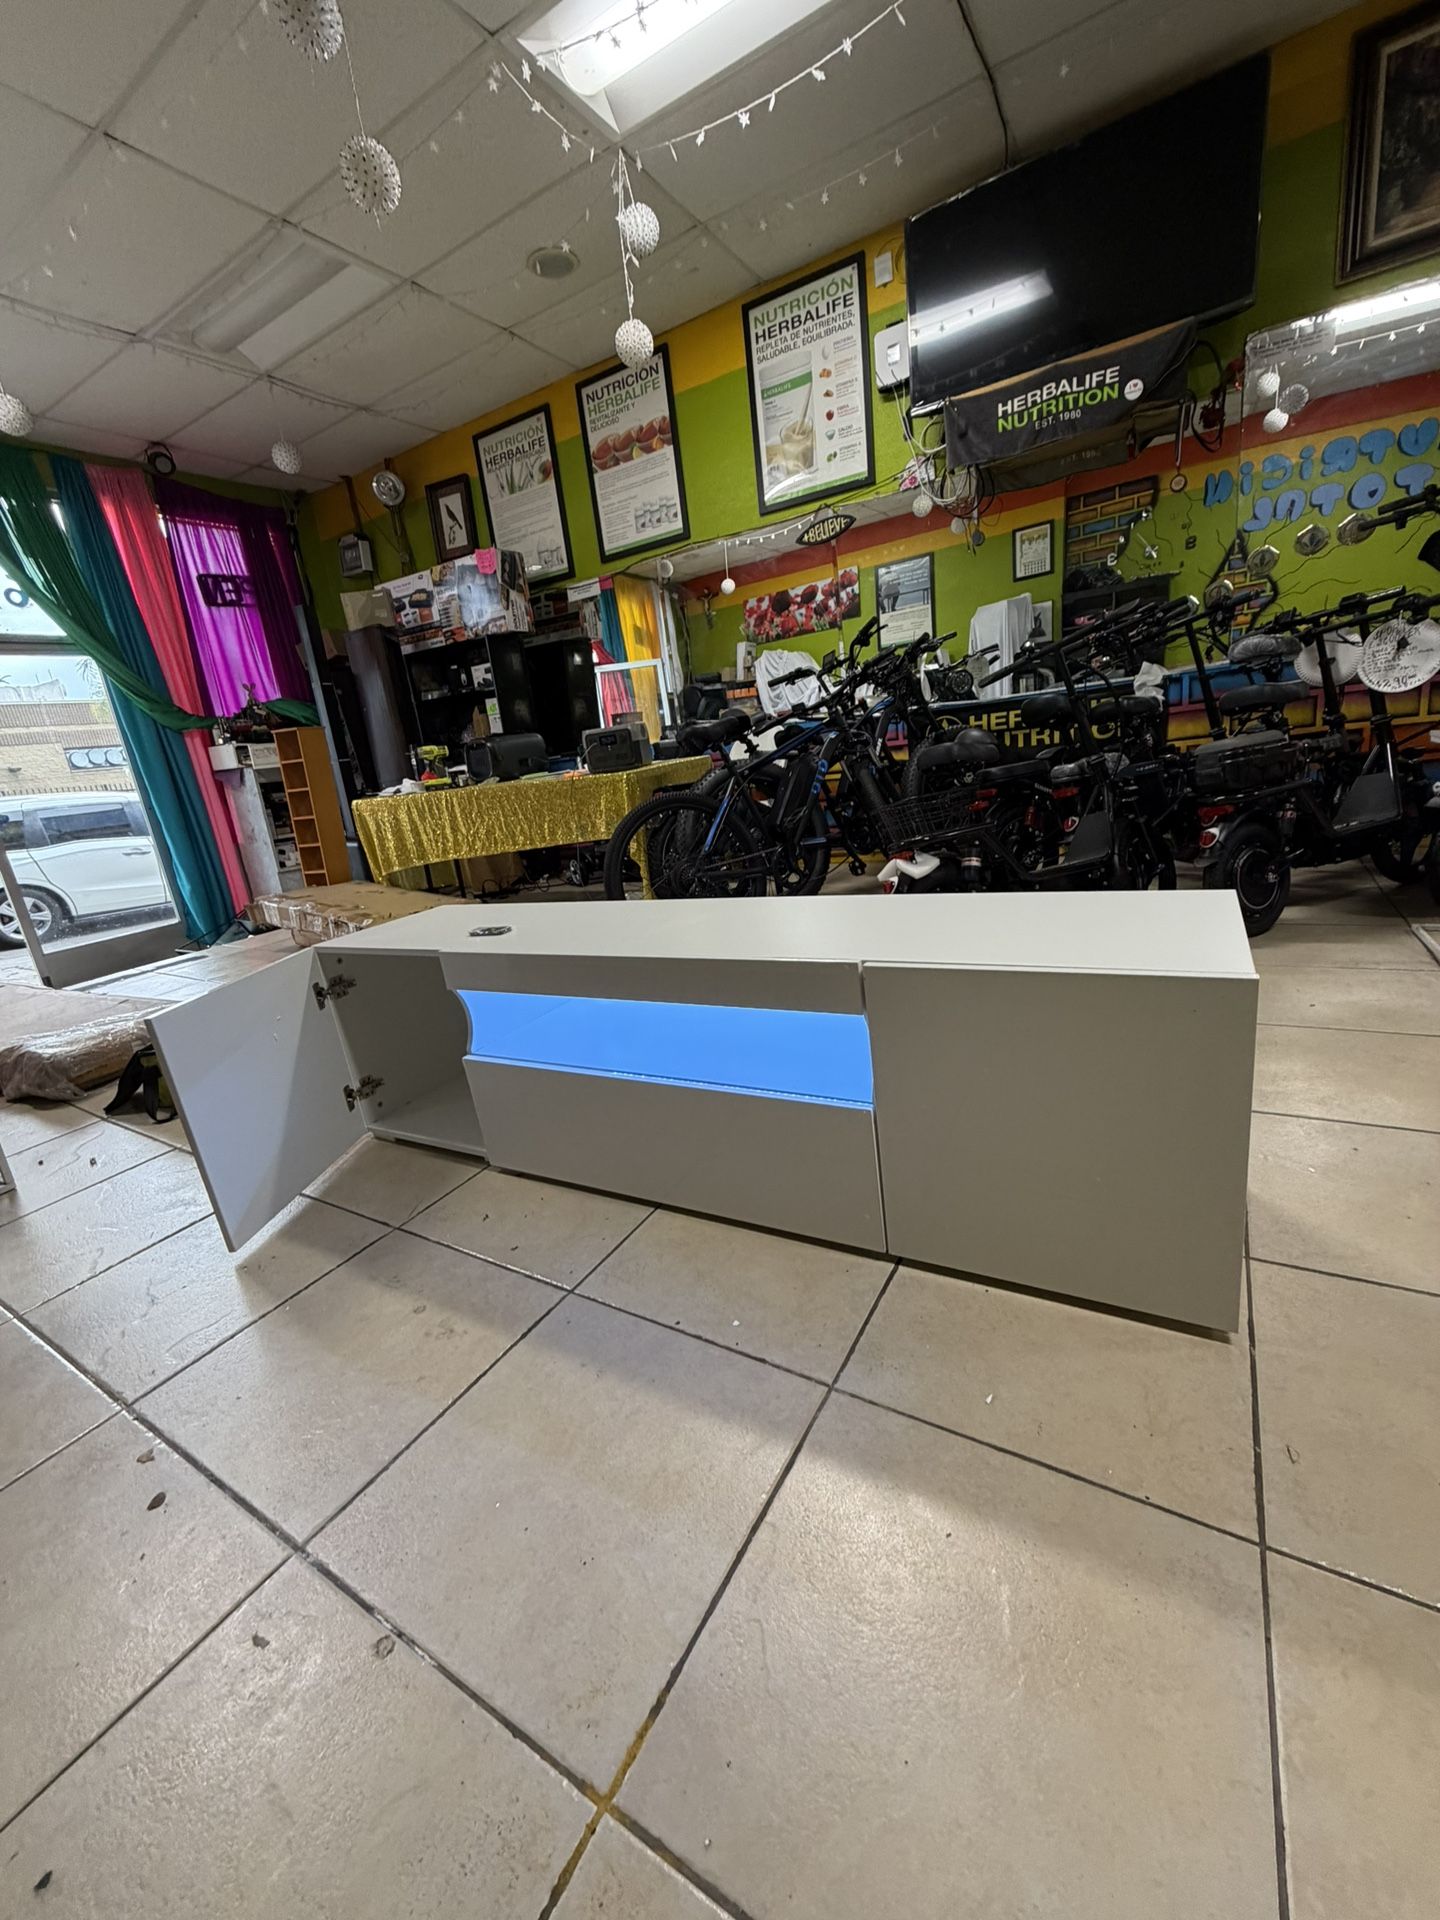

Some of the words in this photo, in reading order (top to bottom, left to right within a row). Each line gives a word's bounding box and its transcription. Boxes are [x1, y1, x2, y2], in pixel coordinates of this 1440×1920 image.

[753, 274, 854, 329] NUTRICIÓN
[755, 291, 855, 345] HERBALIFE
[756, 335, 789, 355] REPLETA
[790, 329, 801, 341] DE
[802, 309, 856, 336] NUTRIENTES,
[757, 341, 801, 365] SALUDABLE,
[802, 319, 856, 346] EQUILIBRADA.
[587, 376, 661, 418] HERBALIFE
[997, 383, 1120, 433] NUTRITION
[998, 365, 1121, 417] HERBALIFE
[1035, 415, 1056, 430] EST.
[1059, 408, 1082, 422] 1980
[485, 435, 546, 469] HERBALIFE
